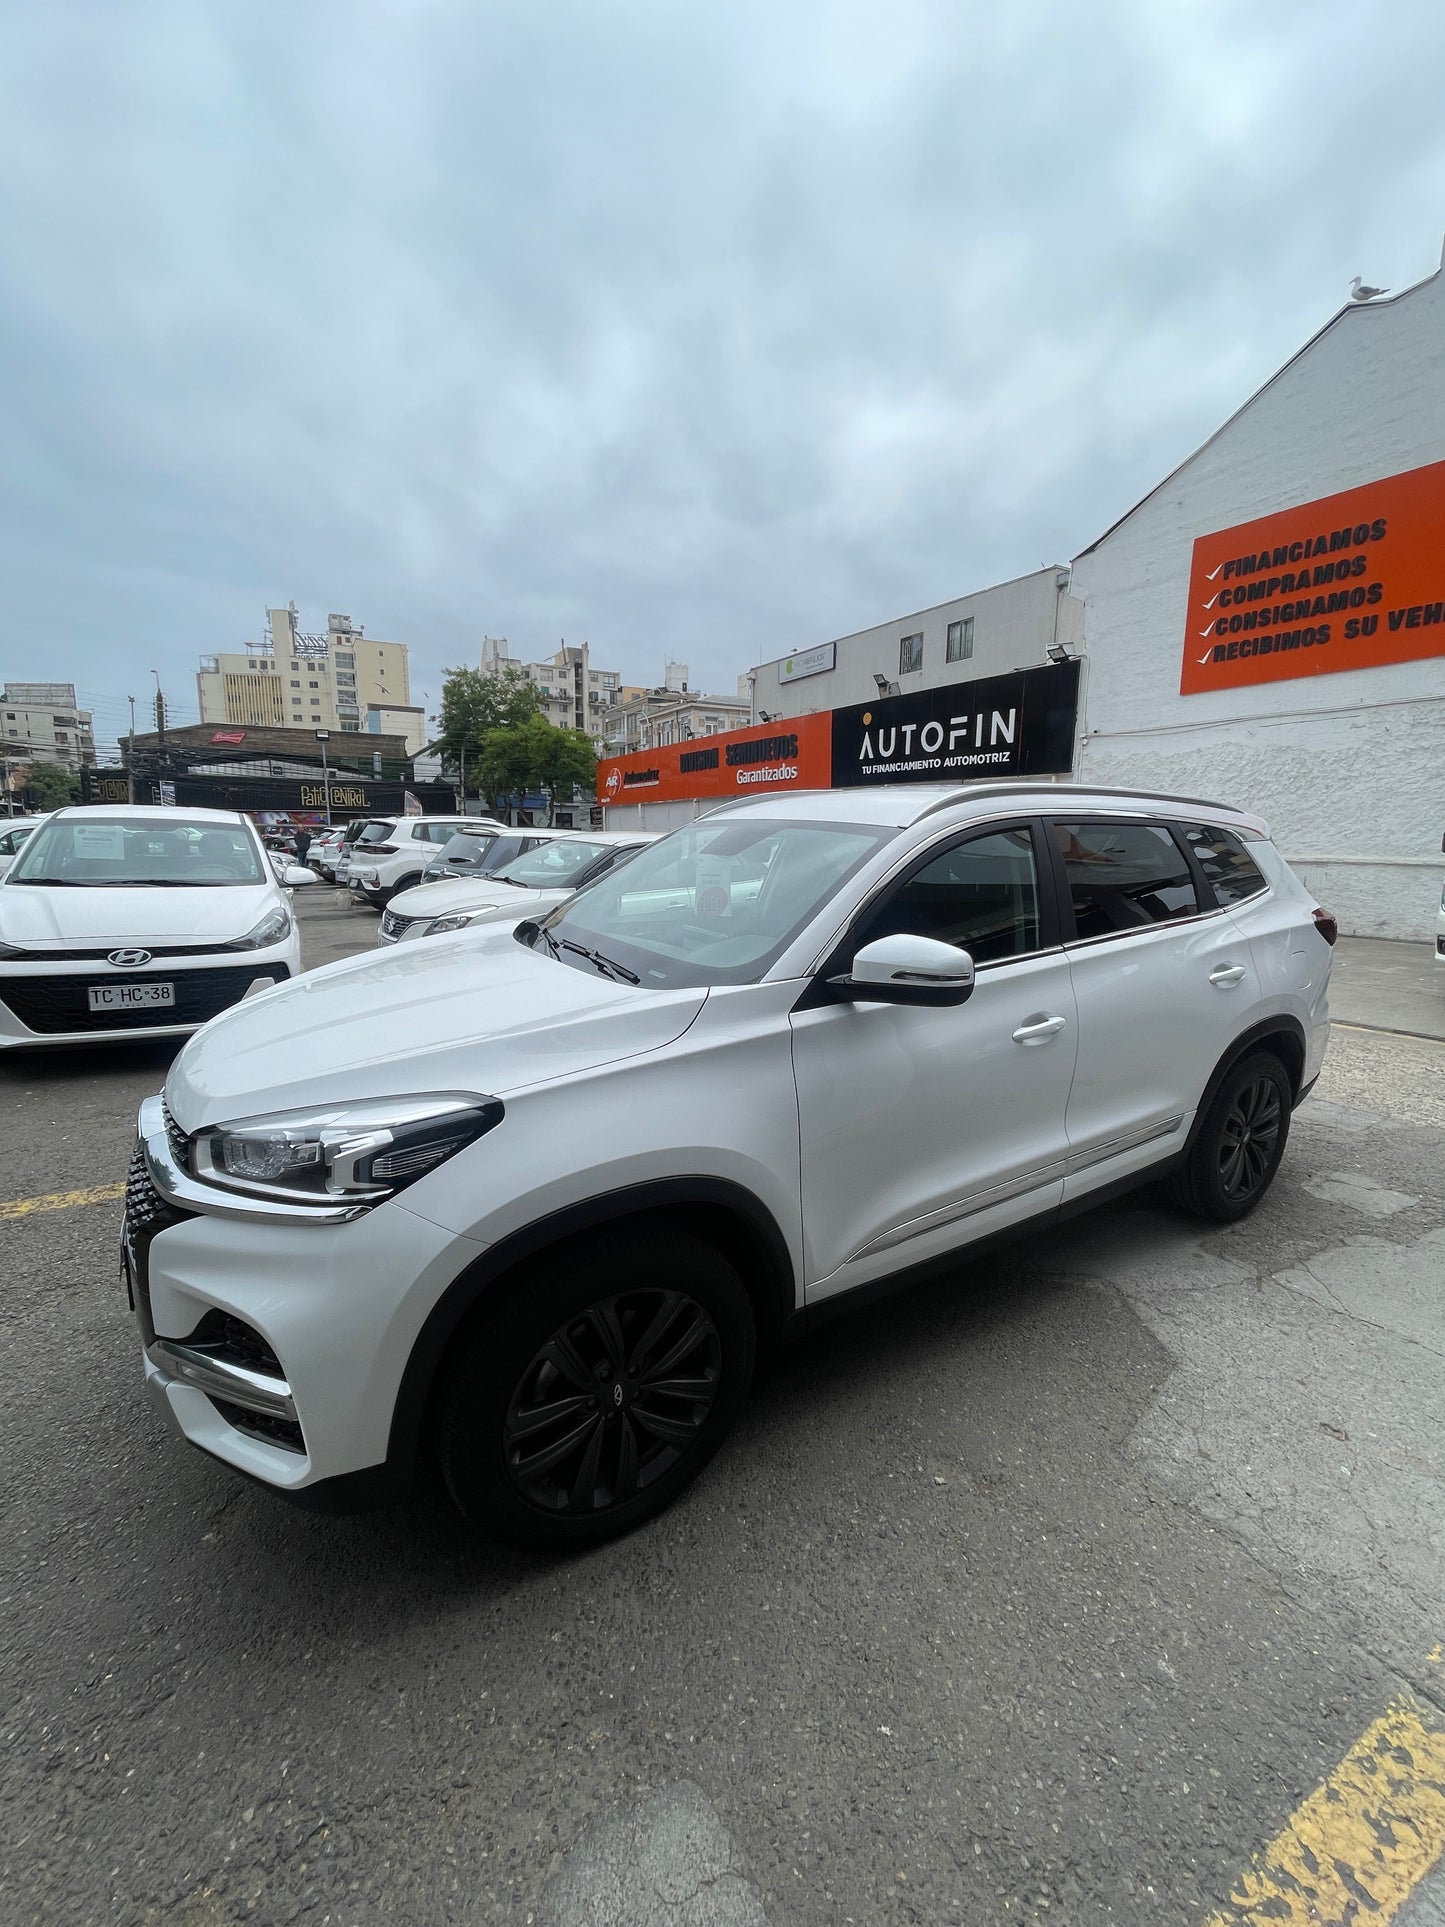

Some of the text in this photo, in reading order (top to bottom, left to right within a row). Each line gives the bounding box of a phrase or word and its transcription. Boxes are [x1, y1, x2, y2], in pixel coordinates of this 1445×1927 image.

[1223, 518, 1387, 580] FINANCIAMOS
[1219, 555, 1367, 608] COMPRAMOS
[1215, 582, 1384, 636] CONSIGNAMOS
[1213, 624, 1331, 662] RECIBIMOS
[1344, 614, 1379, 640] SU
[726, 734, 798, 766] SEMINUEVOS
[859, 708, 1016, 760] AUTOFIN
[737, 763, 798, 784] Garantizados
[862, 751, 1010, 775] TU FINANCIAMIENTO AUTOMOTRIZ
